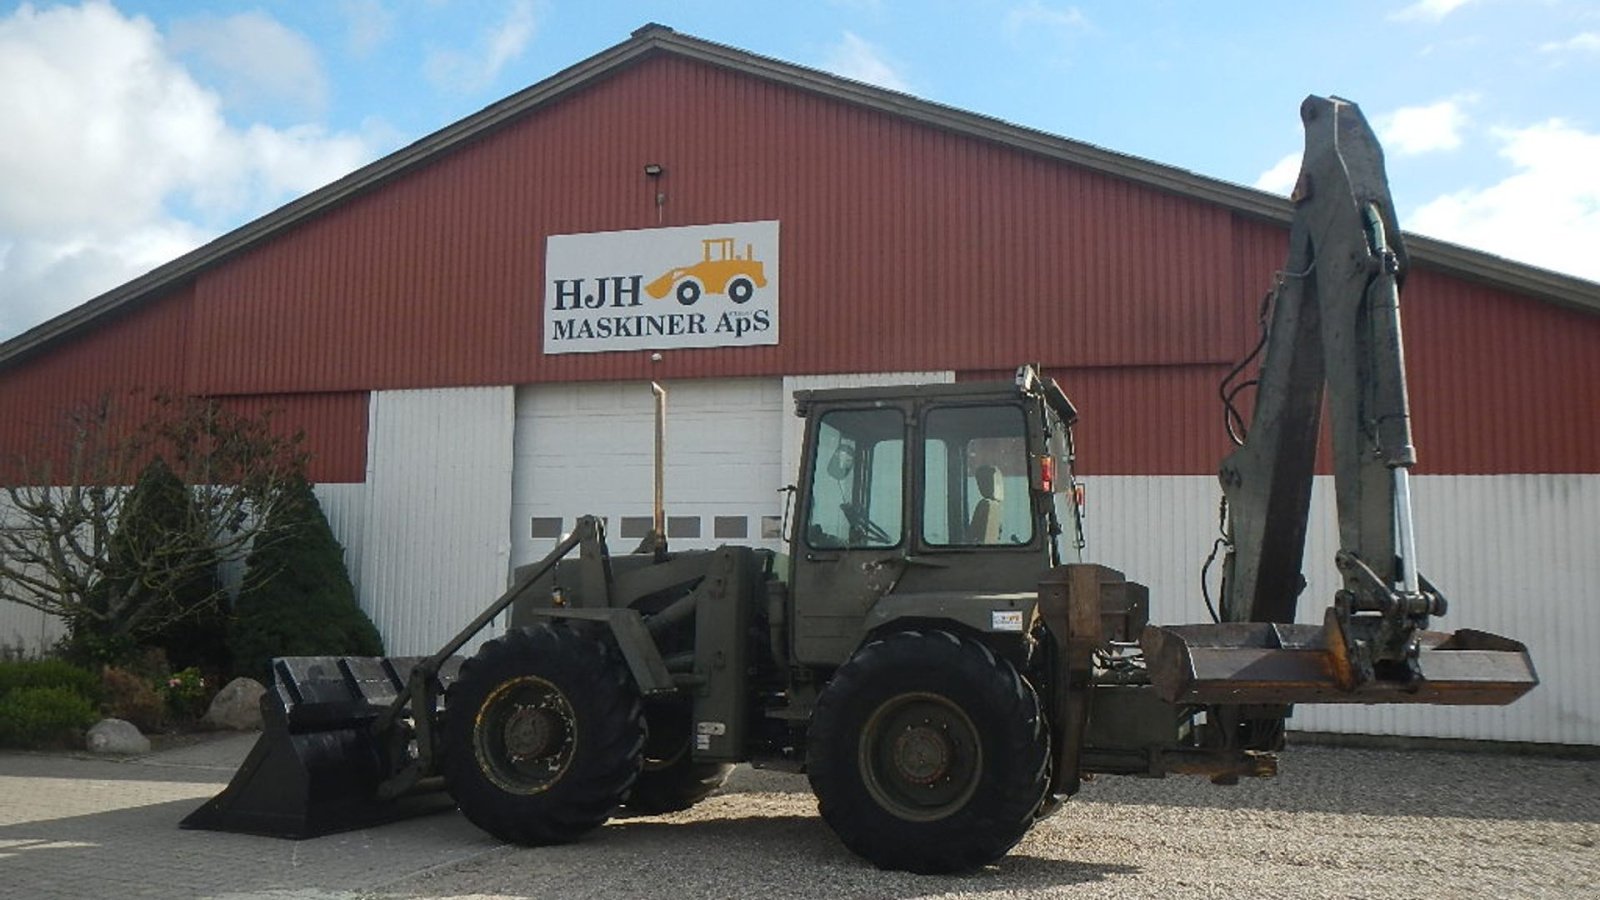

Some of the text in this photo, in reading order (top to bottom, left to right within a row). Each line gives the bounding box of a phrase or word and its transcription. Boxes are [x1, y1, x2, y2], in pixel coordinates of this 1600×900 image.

[552, 275, 643, 310] HJH
[552, 309, 770, 340] MASKINER ApS
